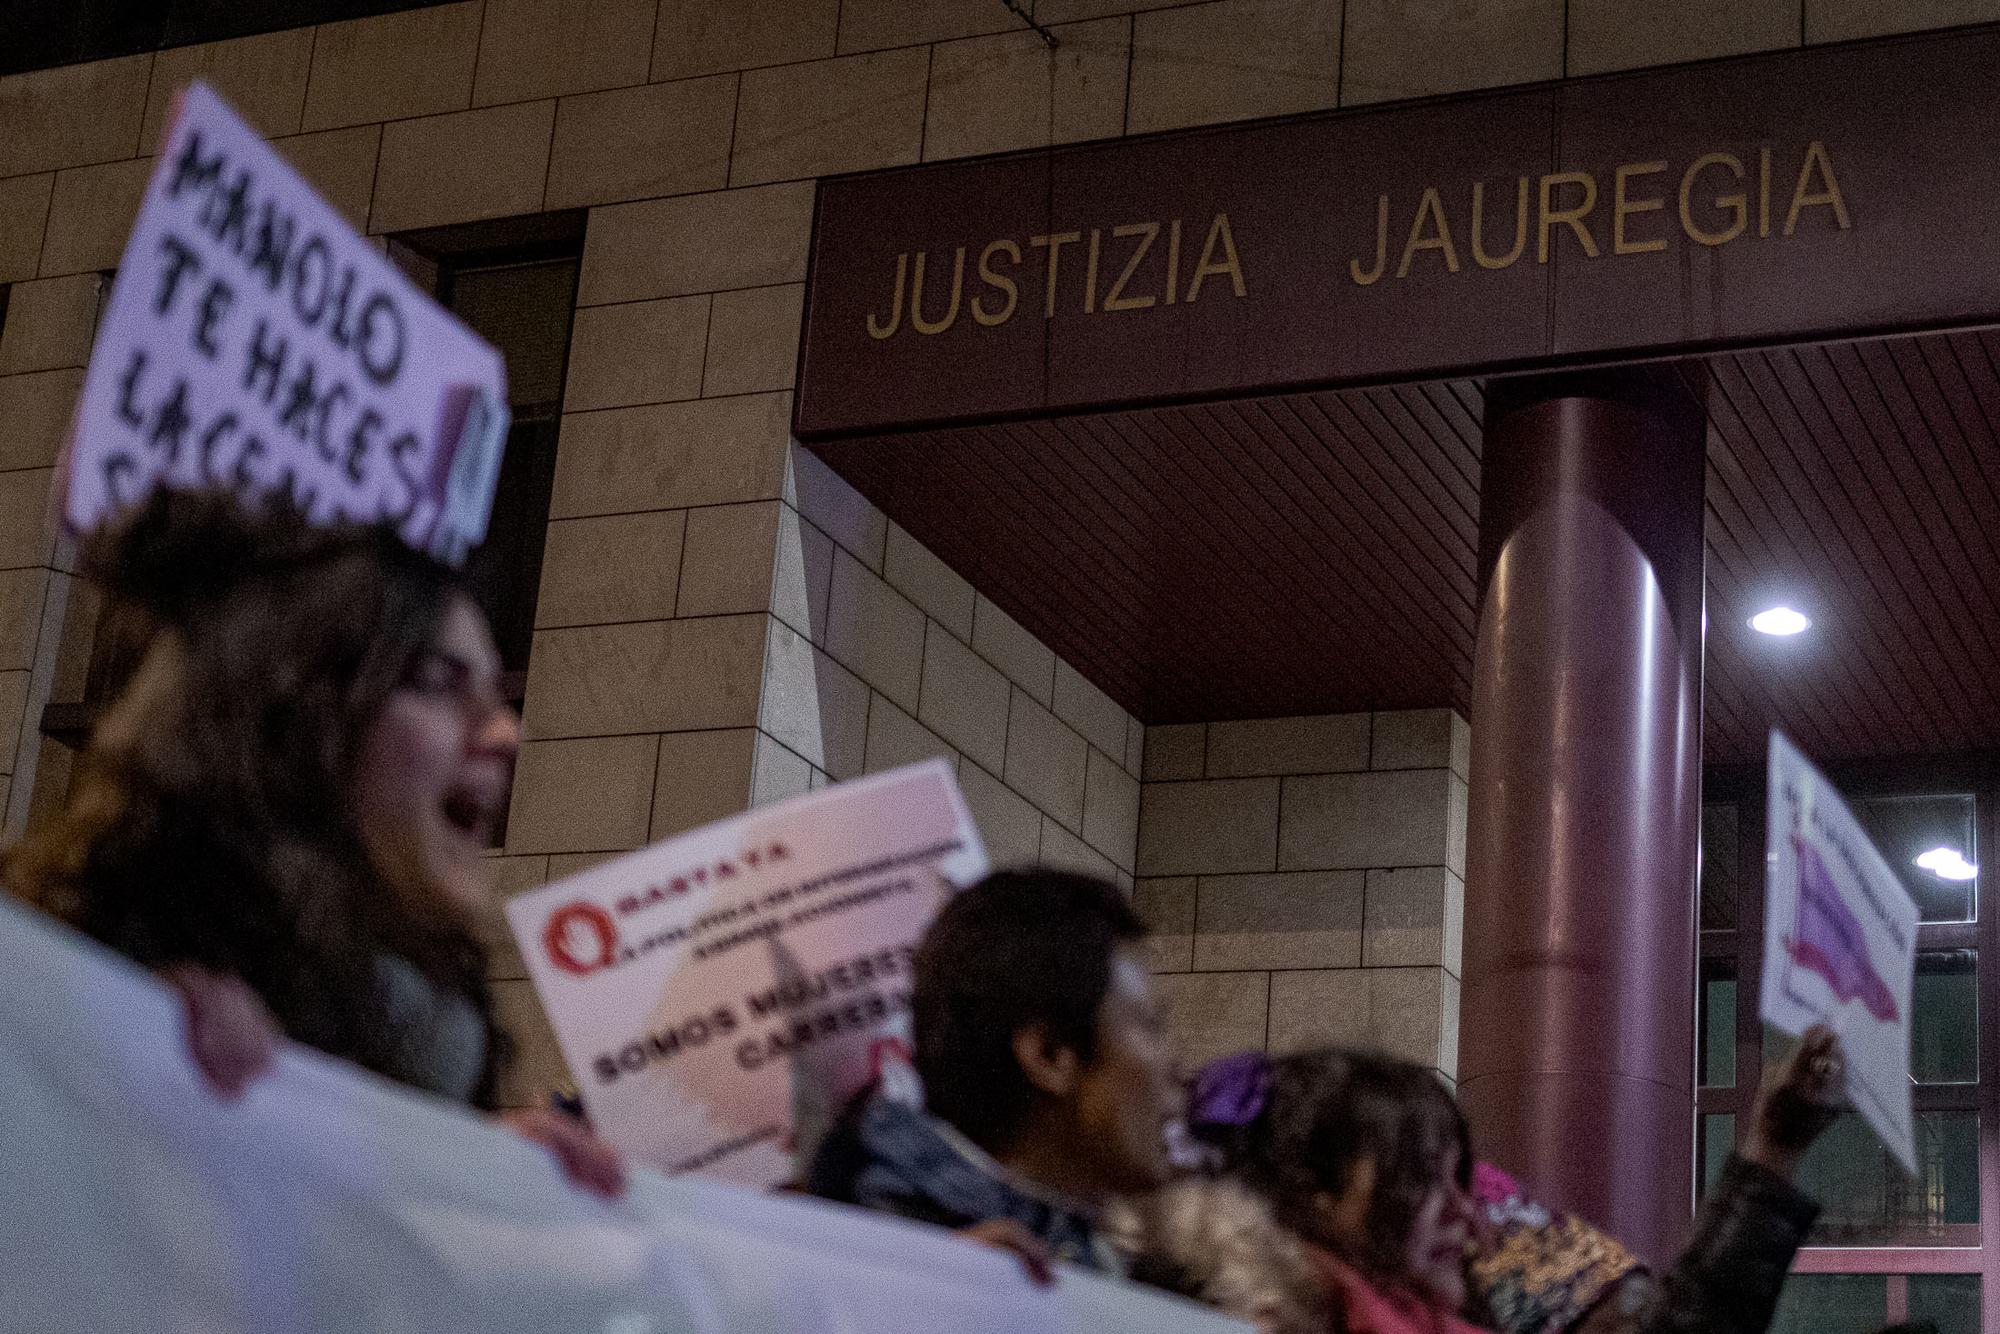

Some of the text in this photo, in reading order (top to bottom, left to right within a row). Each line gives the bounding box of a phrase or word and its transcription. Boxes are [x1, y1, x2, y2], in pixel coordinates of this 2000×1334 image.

[168, 131, 407, 387] MANOLO
[866, 140, 1852, 340] JUSTIZIA JAUREGIA
[118, 349, 193, 461] LA
[155, 234, 425, 514] TE HACES
[592, 1004, 741, 1084] SOMOS
